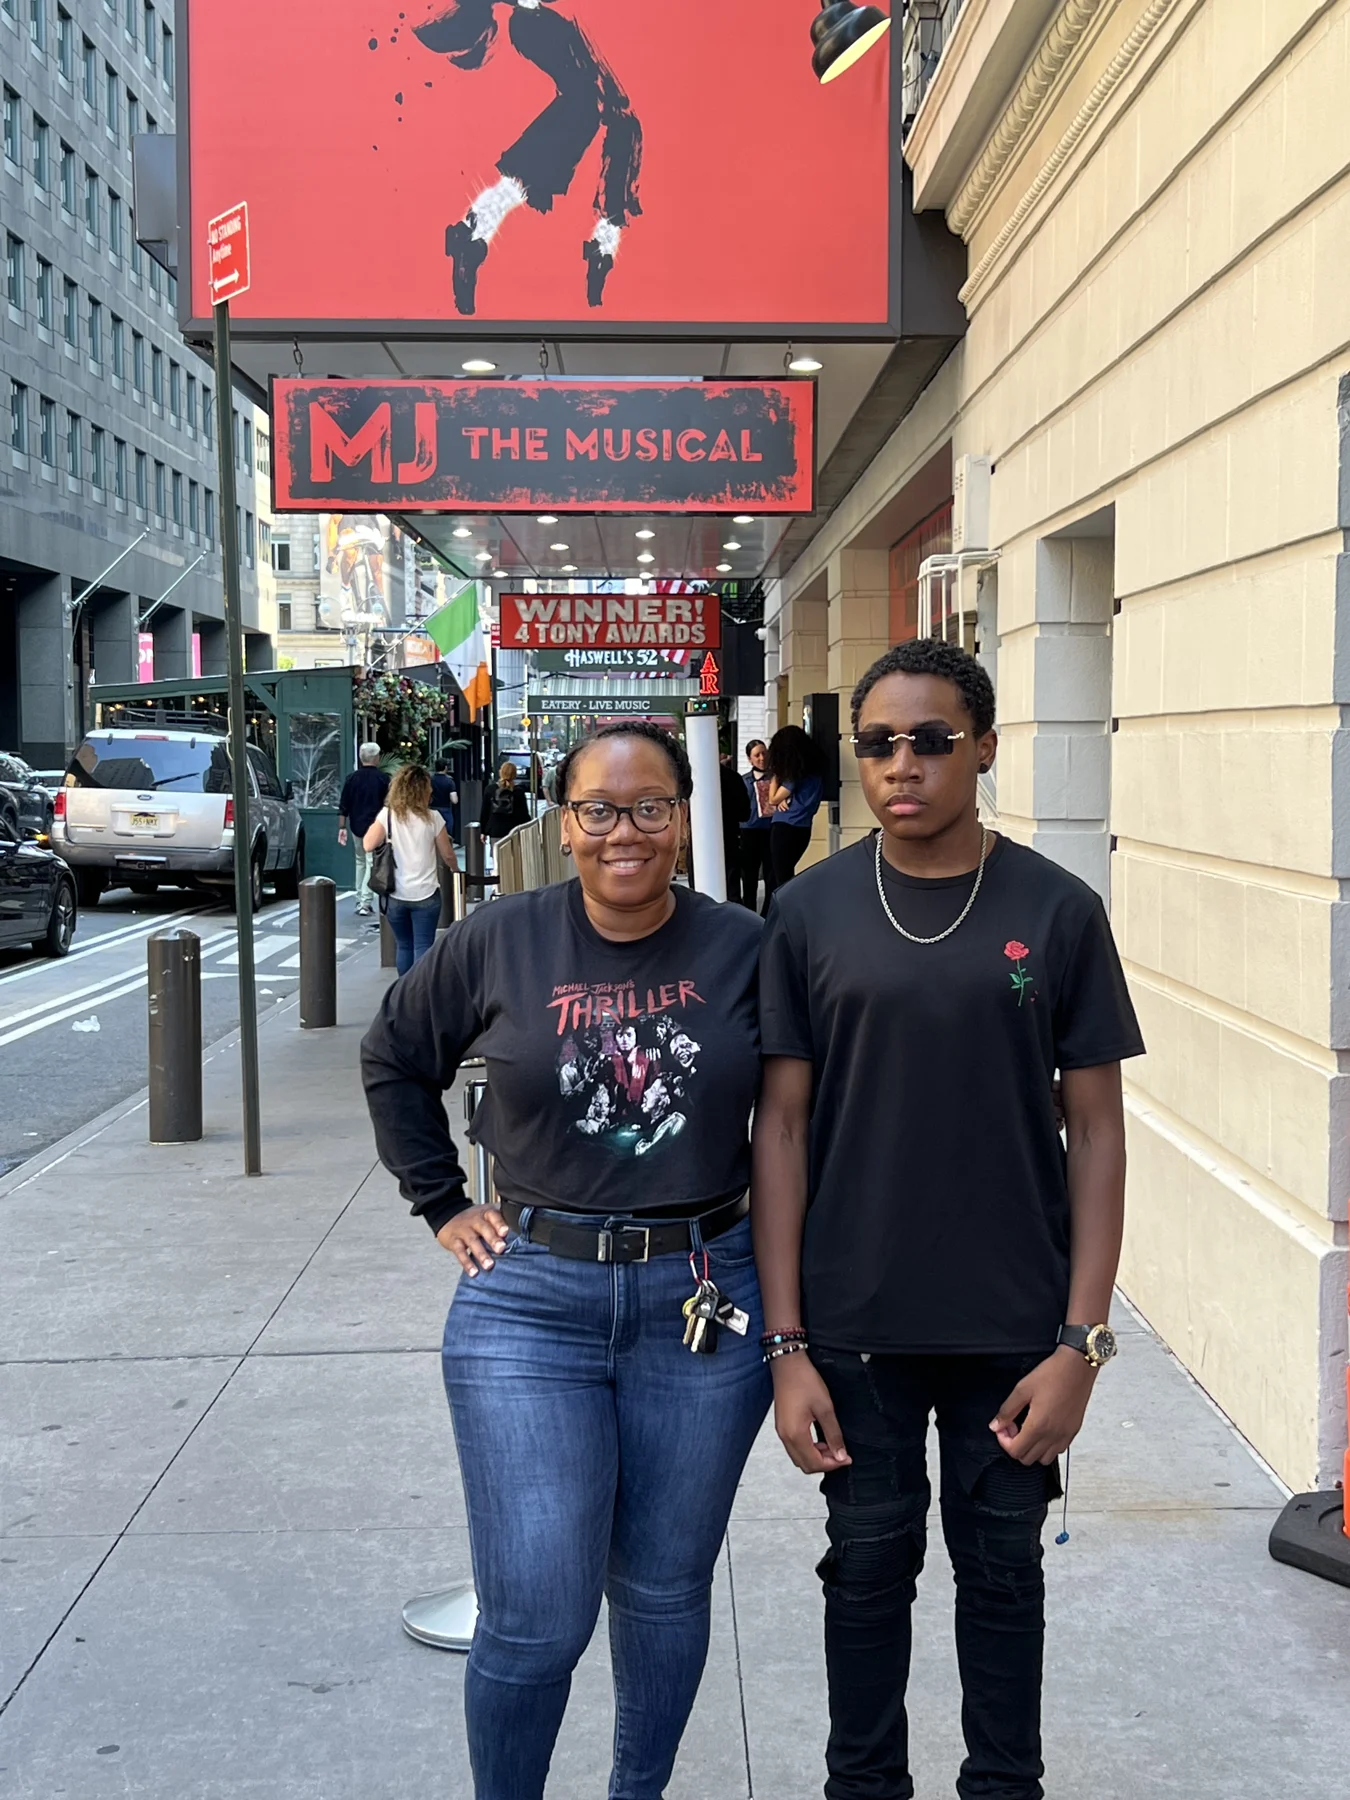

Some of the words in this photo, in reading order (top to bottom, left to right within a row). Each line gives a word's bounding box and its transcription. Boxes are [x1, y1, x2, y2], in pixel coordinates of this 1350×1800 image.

[309, 401, 439, 485] MJ
[462, 426, 549, 462] THE
[565, 426, 763, 463] MUSICAL
[514, 599, 704, 623] WINNER!
[514, 623, 530, 643] 4
[535, 623, 599, 643] TONY
[605, 623, 706, 643] AWARDS
[564, 649, 633, 667] HASWELL'S
[637, 649, 658, 666] 52
[541, 700, 582, 710] EATERY
[588, 700, 614, 710] LIVE
[615, 700, 650, 710] MUSIC
[552, 983, 590, 997] MICHAEL
[546, 980, 707, 1036] THRILLER
